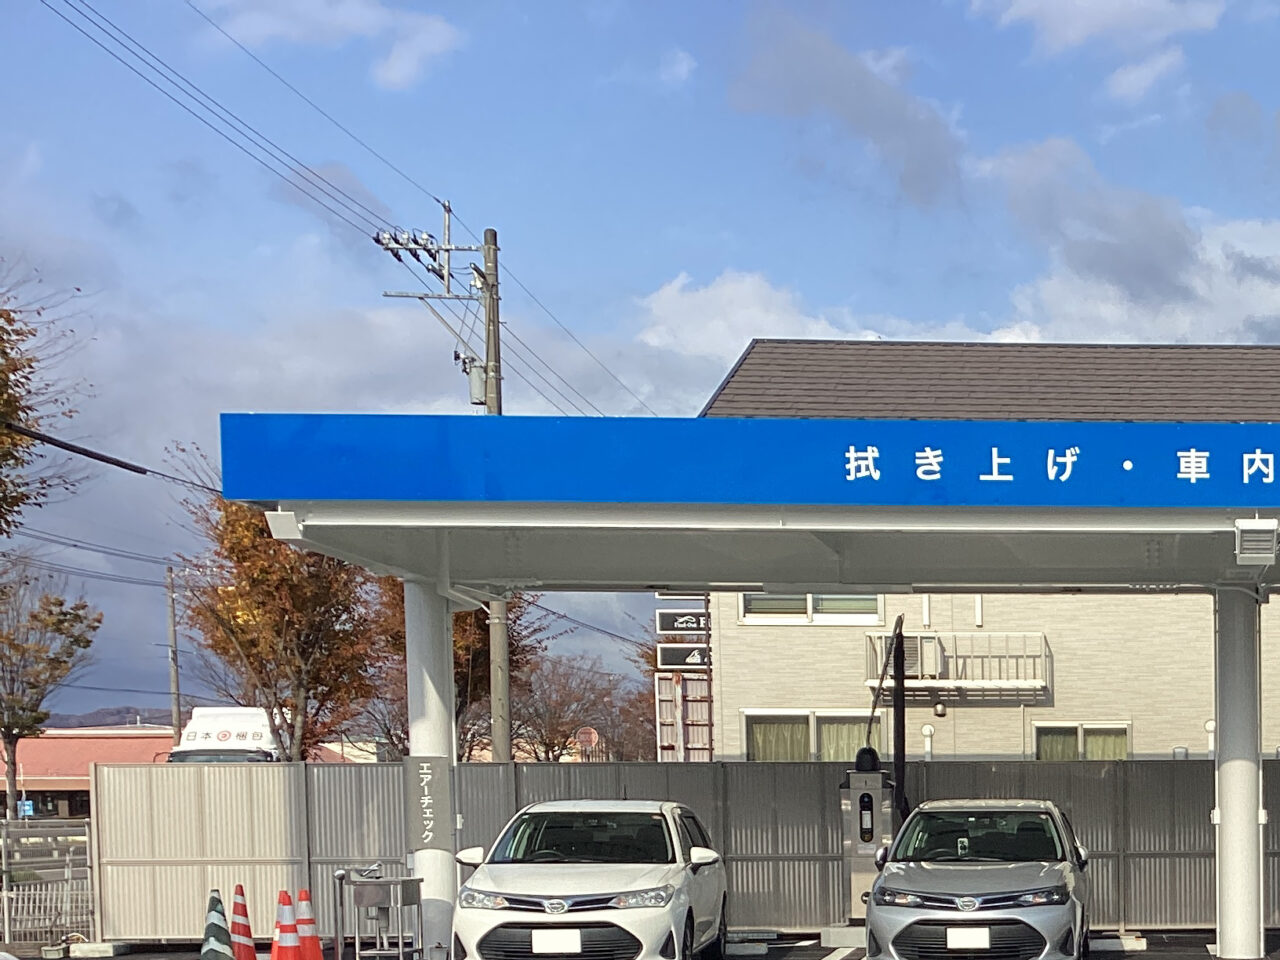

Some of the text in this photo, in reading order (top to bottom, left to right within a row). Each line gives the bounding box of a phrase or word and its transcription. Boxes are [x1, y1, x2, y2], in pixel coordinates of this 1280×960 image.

[419, 763, 434, 843] エアーチェック
